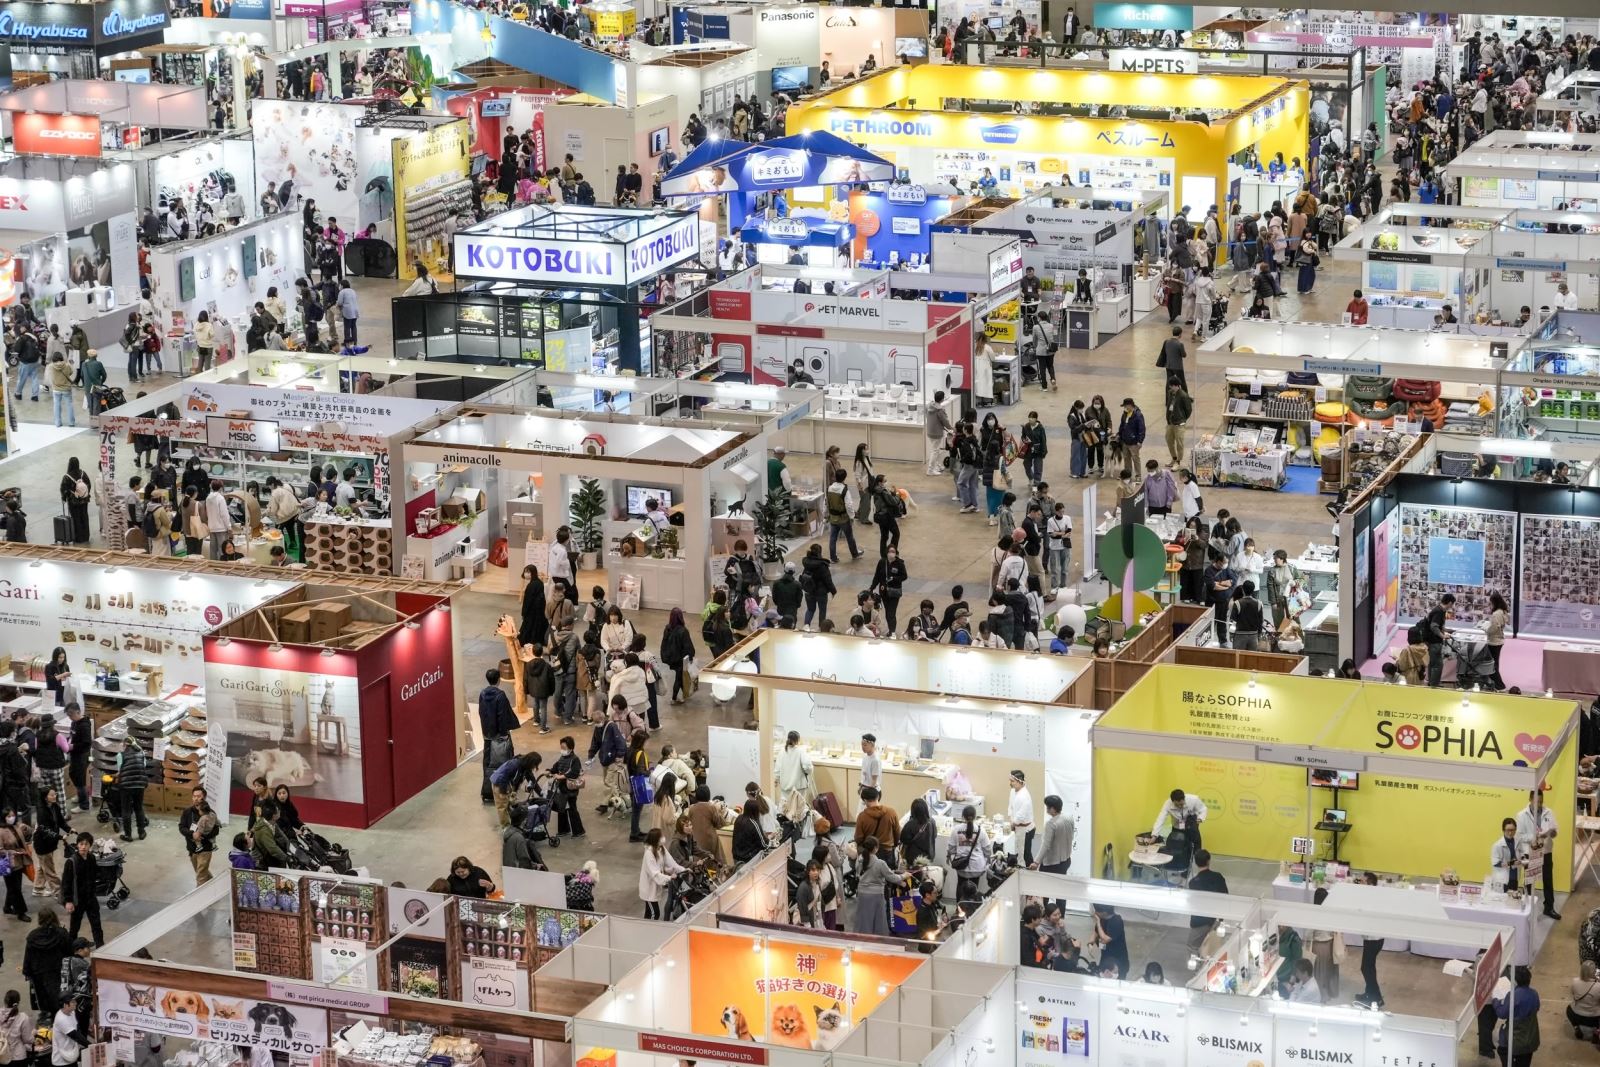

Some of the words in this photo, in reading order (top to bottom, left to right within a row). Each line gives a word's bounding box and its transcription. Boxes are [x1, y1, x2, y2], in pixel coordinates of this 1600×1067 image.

[119, 13, 165, 32] Hayabusa
[761, 10, 815, 21] Panasonic
[12, 23, 88, 39] Hayabusa
[1122, 59, 1185, 73] M-PETS
[831, 119, 932, 136] PETHROOM
[1096, 131, 1175, 148] ペスルーム
[757, 166, 800, 176] キミおもい
[891, 190, 923, 200] キミおもい
[772, 224, 803, 234] キミおもい
[631, 224, 694, 273] KOTOBUKI
[467, 243, 613, 276] KOTOBUKI
[818, 305, 836, 314] PET
[839, 306, 880, 317] MARVEL
[229, 432, 257, 442] MSBC
[443, 453, 501, 466] animacolle
[1245, 459, 1272, 470] kitchen
[401, 665, 442, 701] GariGari
[1182, 690, 1272, 710] 腸ならSOPHIA
[797, 954, 816, 974] 神
[478, 986, 512, 997] げんかつ
[309, 994, 325, 1003] pirica
[325, 996, 348, 1006] medical
[349, 1000, 370, 1009] GROUP
[1047, 998, 1076, 1007] ARTEMIS
[1029, 1014, 1052, 1023] FRESH
[1131, 1009, 1160, 1018] ARTEMIS
[1212, 1035, 1263, 1054] BLISMIX
[667, 1044, 694, 1053] CHOICES
[695, 1047, 739, 1059] CORPORATION
[740, 1053, 754, 1061] LTD.
[1300, 1048, 1353, 1064] BLISMIX
